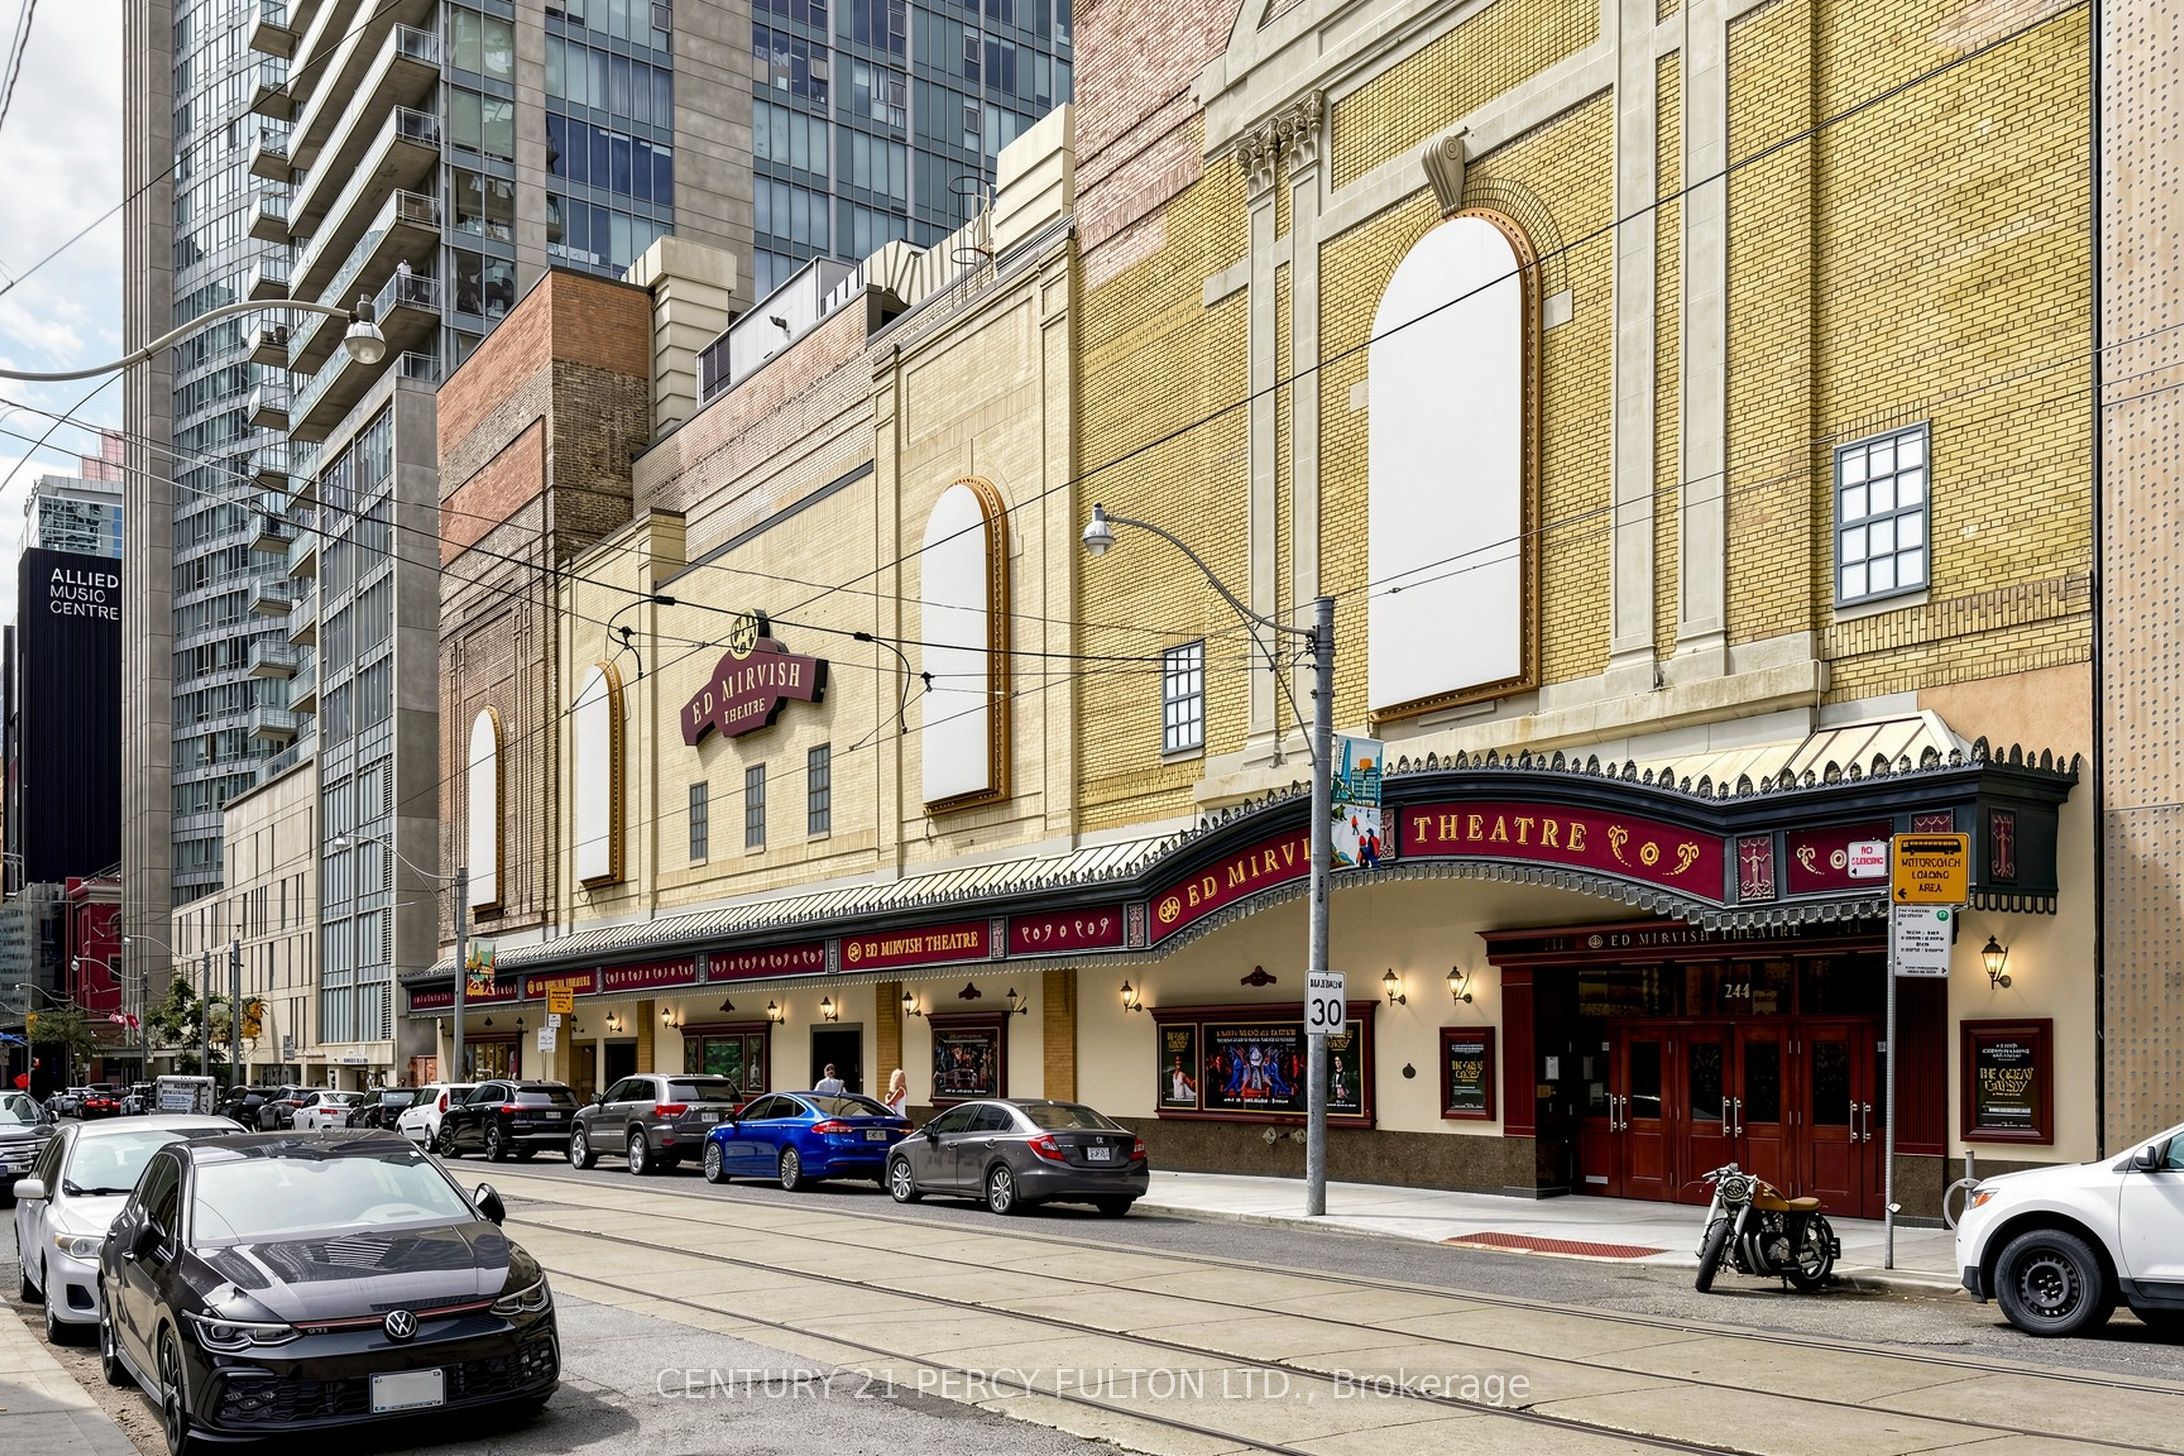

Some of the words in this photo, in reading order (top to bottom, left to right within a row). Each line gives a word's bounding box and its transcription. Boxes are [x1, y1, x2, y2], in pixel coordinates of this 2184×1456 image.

[51, 568, 119, 588] ALLIED
[50, 600, 120, 620] CENTRE
[692, 692, 713, 725] ED
[722, 662, 801, 702] MIRVISH
[724, 697, 766, 725] THEATRE
[1187, 876, 1218, 907] ED
[1227, 837, 1312, 889] MIRVI
[1413, 814, 1587, 852] THEATRE
[881, 937, 923, 956] MIRVISH
[925, 931, 978, 952] THEATRE
[1611, 934, 1630, 947] ED
[1639, 930, 1709, 946] MIRVISH
[1725, 983, 1750, 999] 244
[1310, 998, 1342, 1027] 30
